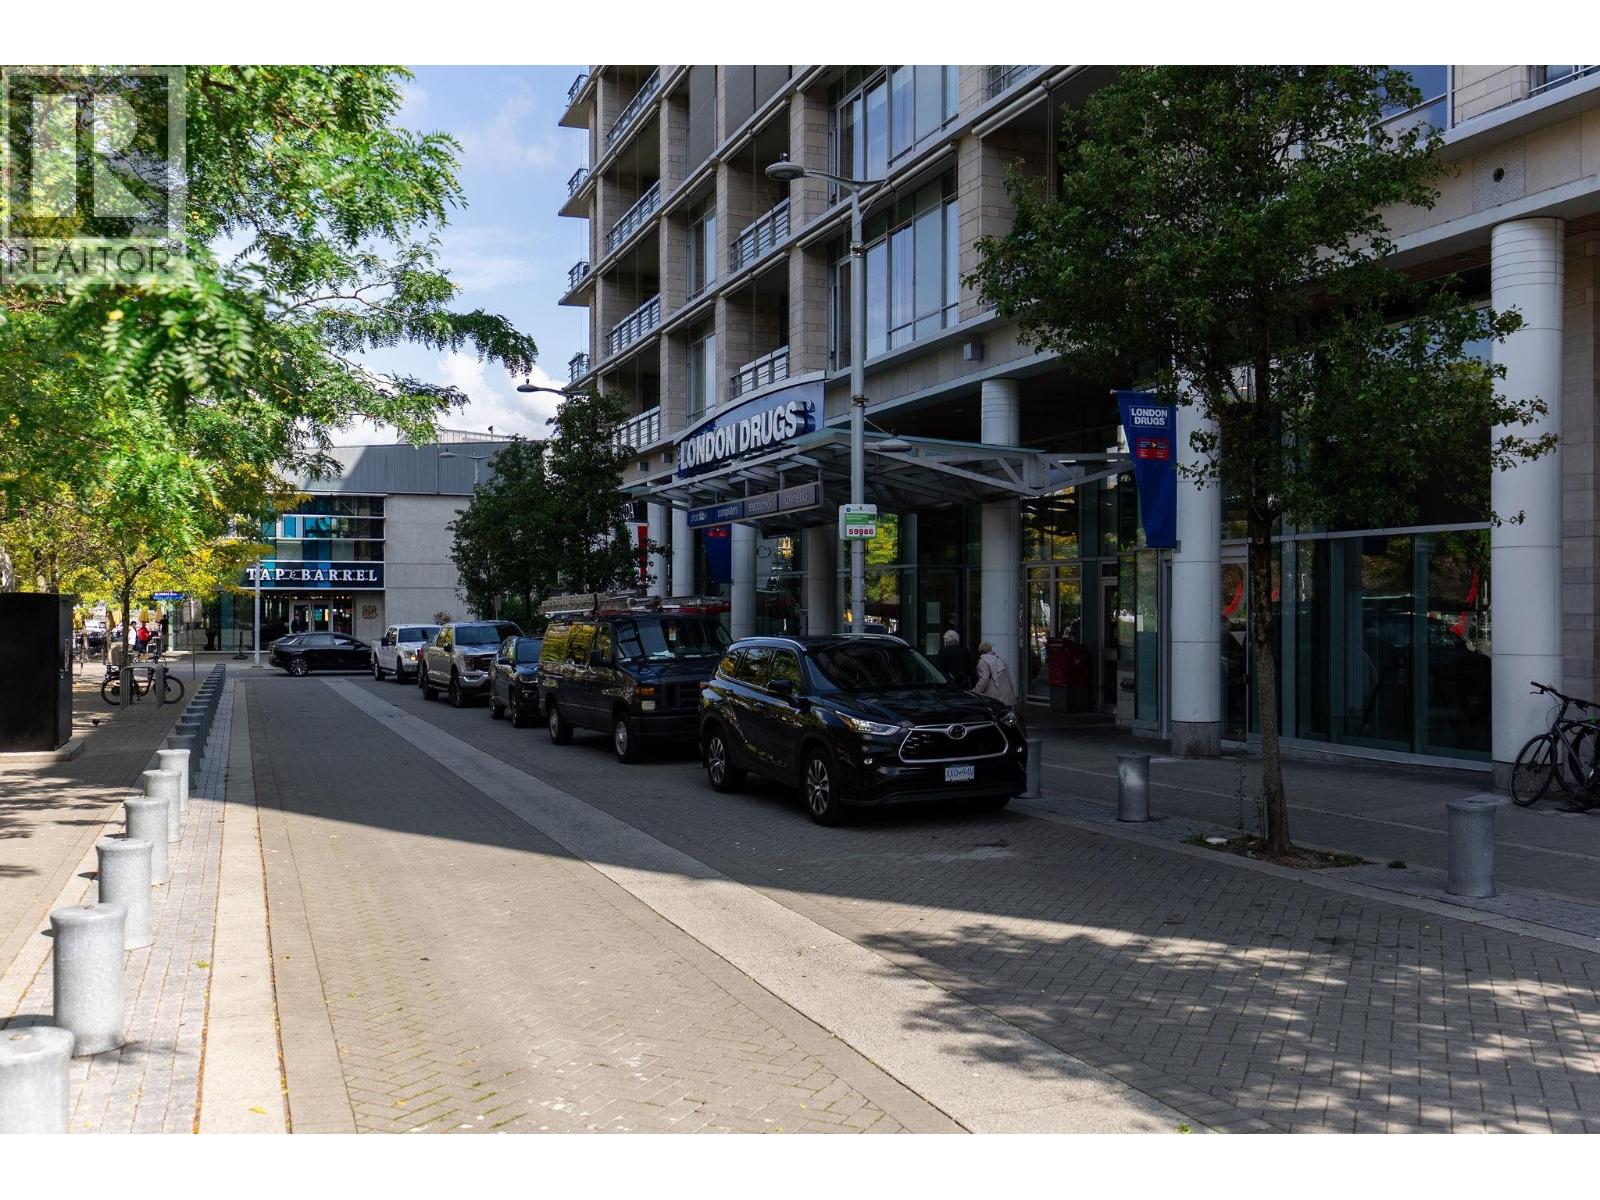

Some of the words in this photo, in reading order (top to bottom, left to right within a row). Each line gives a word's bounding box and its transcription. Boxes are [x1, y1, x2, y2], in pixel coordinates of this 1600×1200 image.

[1131, 408, 1168, 417] LONDON
[1134, 417, 1166, 426] DRUGS
[680, 423, 736, 470] LONDON
[739, 401, 797, 452] DRUGS
[246, 568, 285, 581] TAP
[301, 569, 378, 581] BARREL
